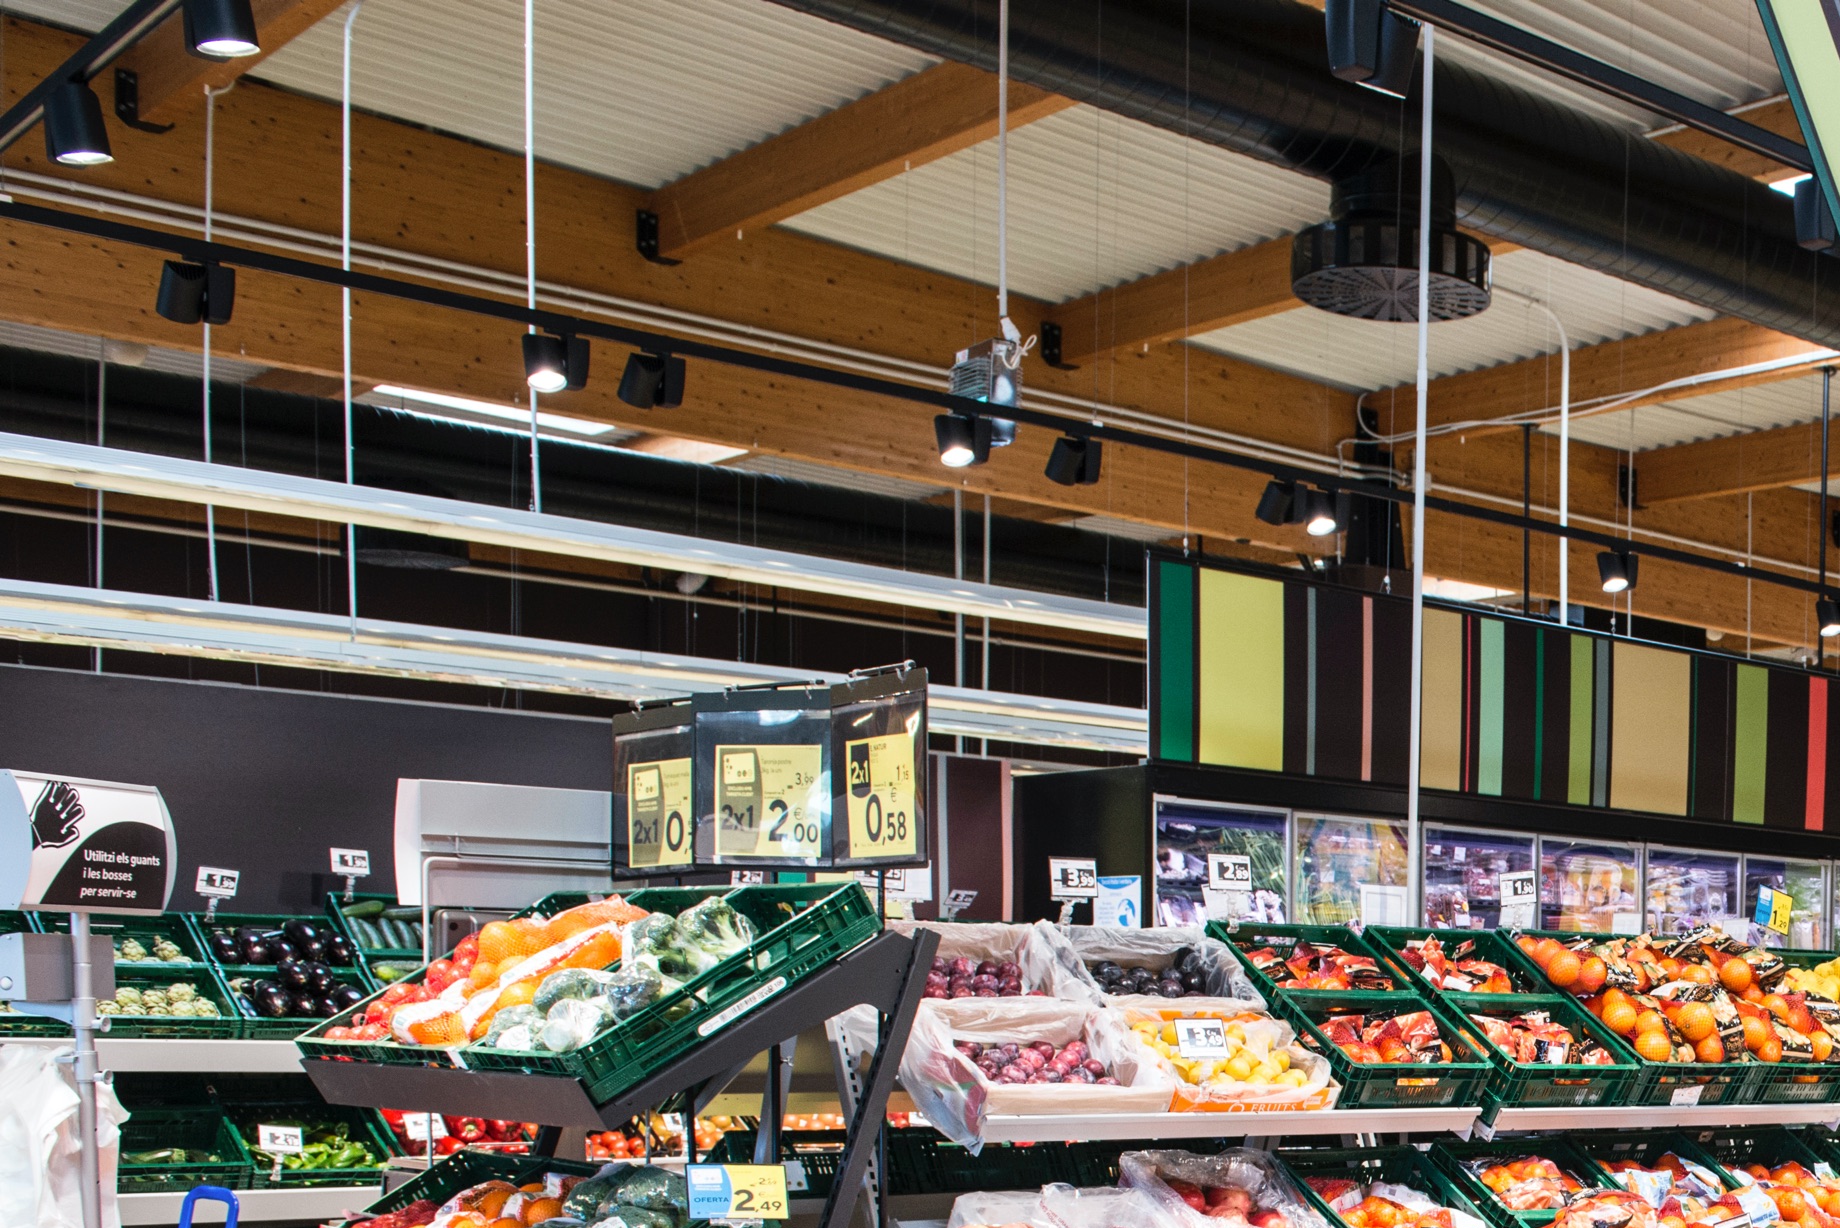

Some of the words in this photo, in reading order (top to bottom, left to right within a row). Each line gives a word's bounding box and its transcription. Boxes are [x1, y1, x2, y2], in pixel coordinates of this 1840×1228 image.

[851, 760, 869, 785] 2x1
[721, 804, 754, 831] 2x1
[768, 799, 818, 843] 200
[866, 794, 907, 846] 0,58
[633, 818, 660, 845] 2x1
[666, 810, 693, 855] 0,
[84, 849, 115, 863] Utilitzi
[116, 852, 129, 864] els
[130, 855, 160, 867] guants
[83, 867, 87, 878] i
[88, 867, 101, 879] les
[102, 868, 132, 881] bosses
[1066, 868, 1095, 888] 3,99
[80, 887, 97, 898] per
[97, 886, 137, 898] servir-se
[734, 1189, 782, 1213] 2,49
